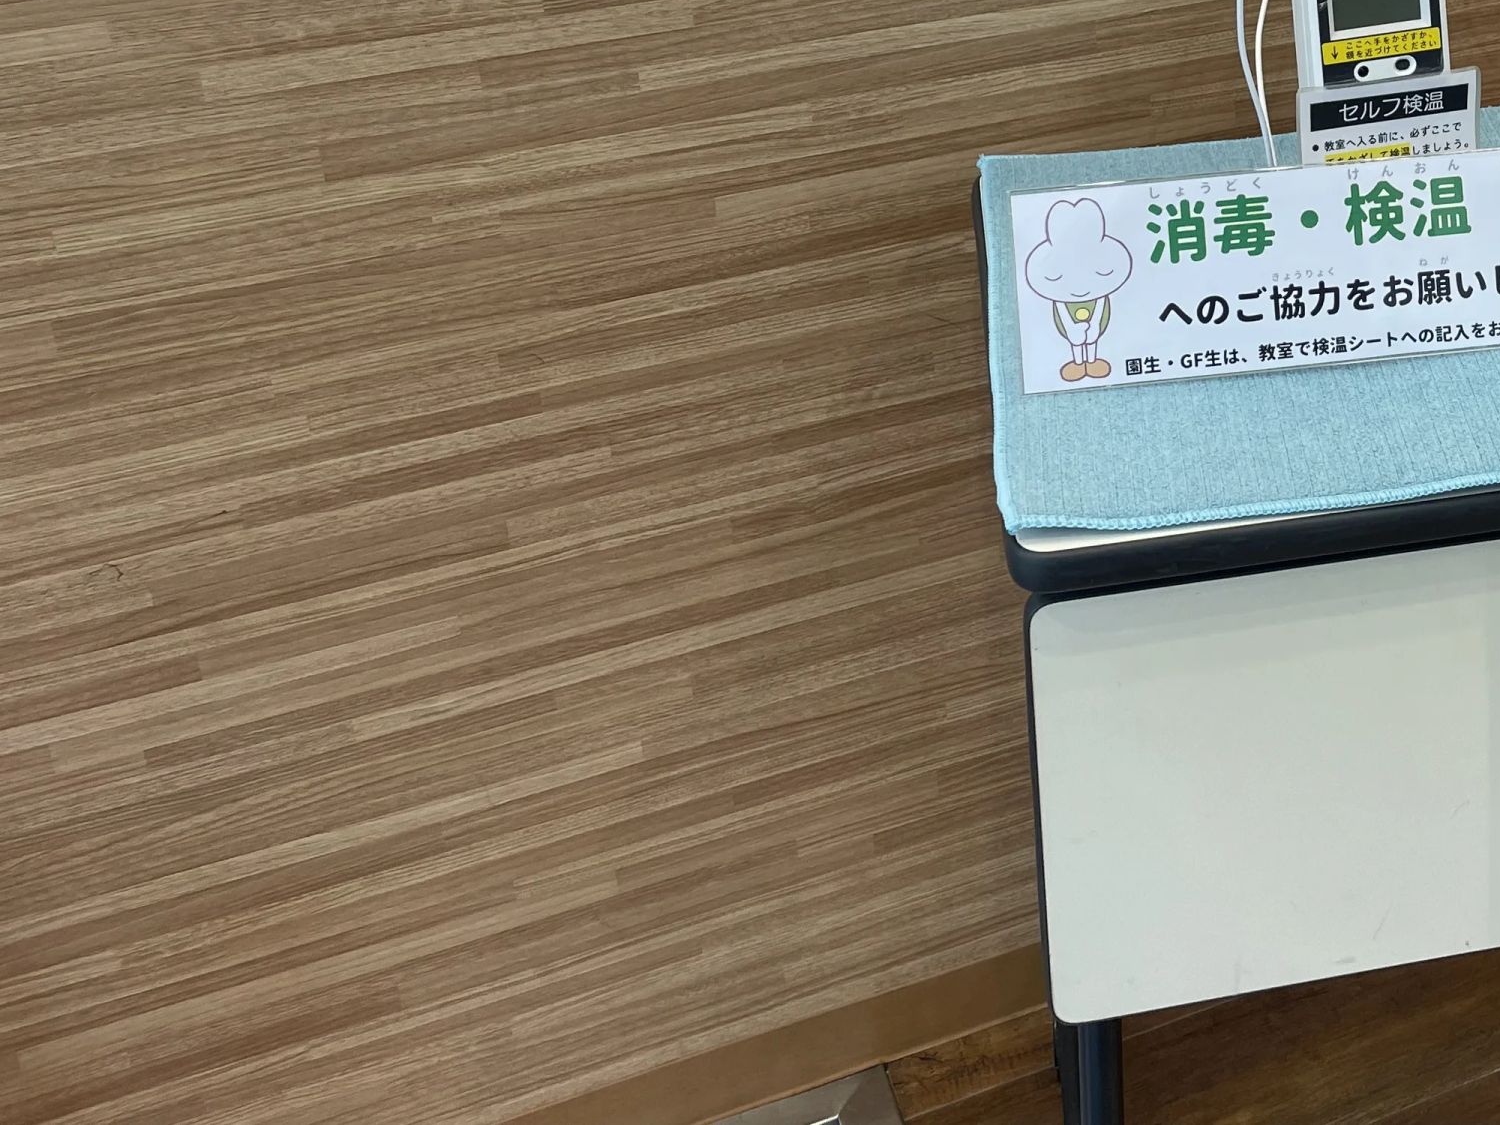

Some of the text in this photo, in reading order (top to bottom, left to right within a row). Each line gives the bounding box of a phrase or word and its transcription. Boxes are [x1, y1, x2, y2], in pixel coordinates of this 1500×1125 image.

[1338, 91, 1444, 122] セルフ検温
[1324, 122, 1462, 152] 教室へ入る前に、必ずここで
[1149, 159, 1461, 201] しょうどく けんおん
[1146, 175, 1472, 264] 消毒・検温
[1271, 255, 1450, 282] きょうりょく ねが
